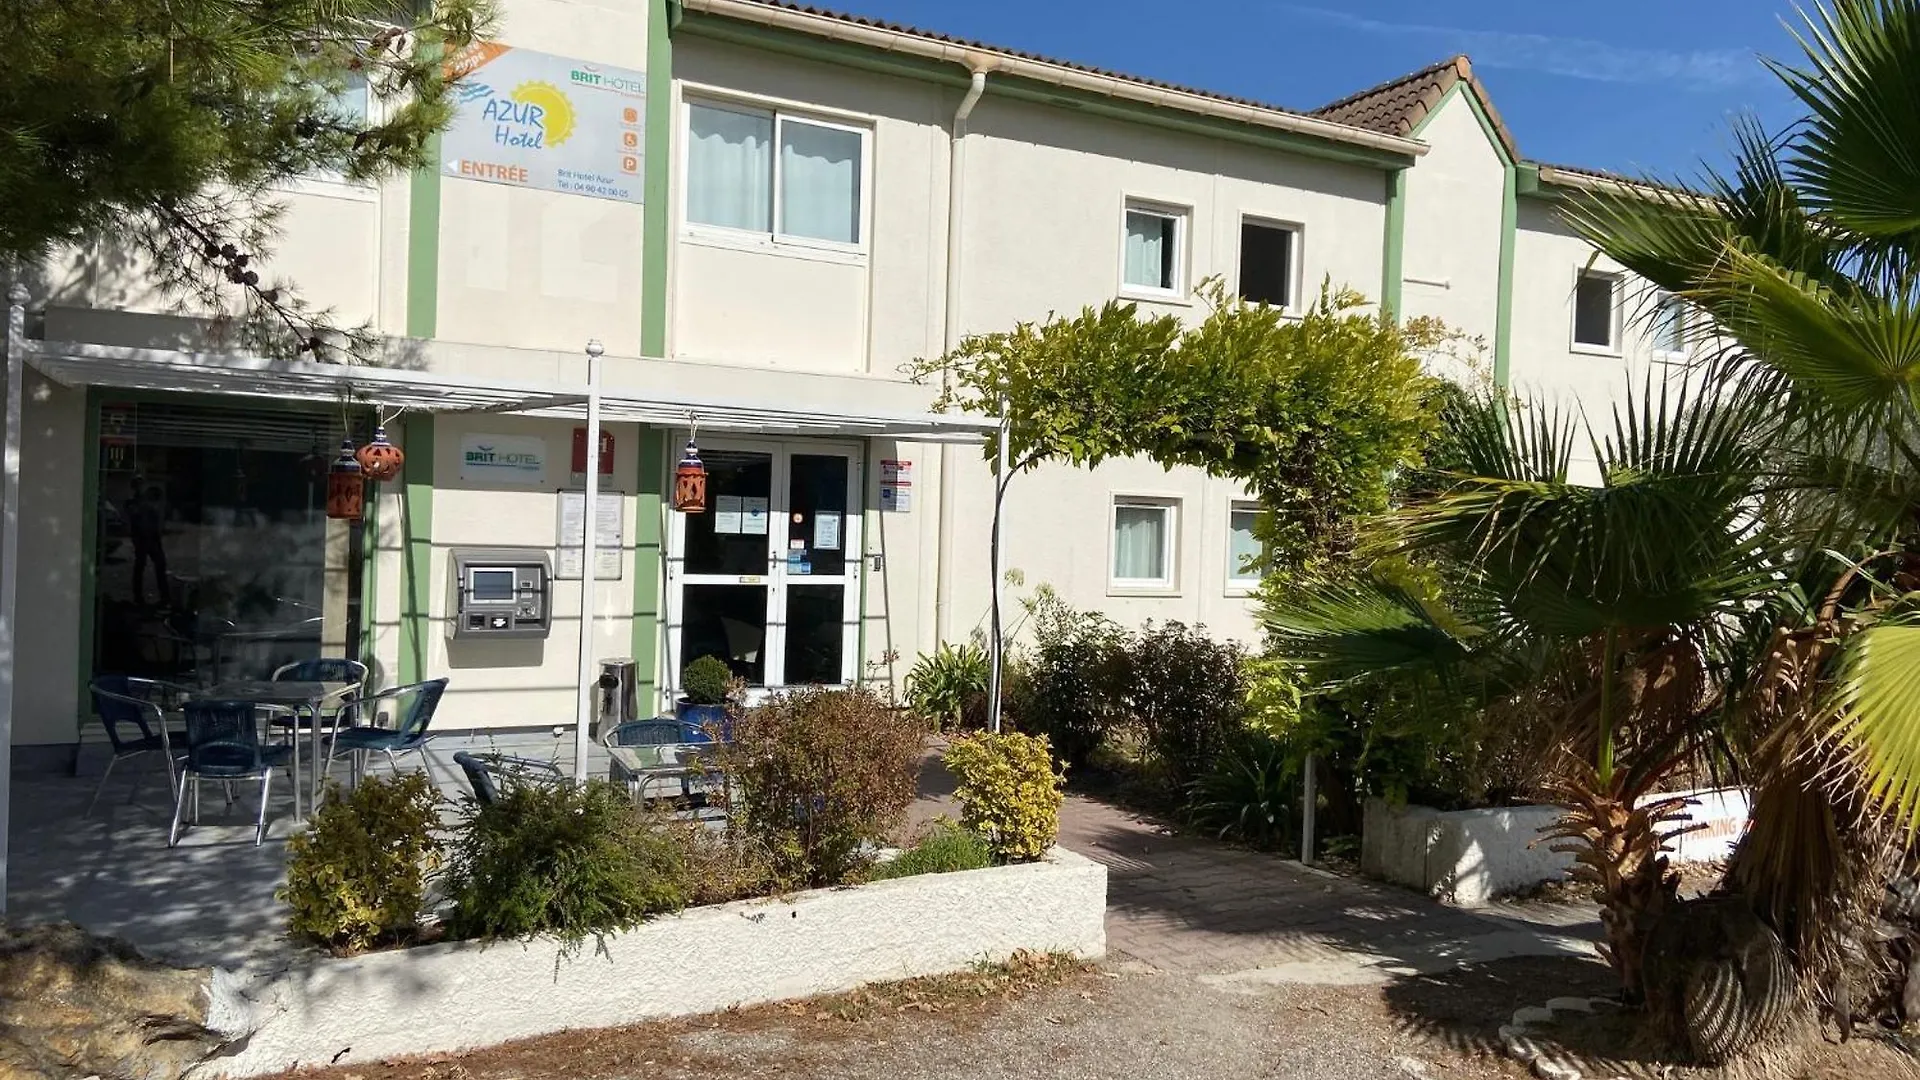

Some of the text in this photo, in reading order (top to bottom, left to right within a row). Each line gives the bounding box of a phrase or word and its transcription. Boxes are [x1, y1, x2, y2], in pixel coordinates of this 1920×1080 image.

[571, 70, 645, 93] BRIT HOTEL
[482, 98, 544, 129] AZUR
[495, 125, 543, 150] Hotel
[461, 160, 529, 183] ENTRÉE
[557, 168, 572, 178] Brit
[596, 175, 614, 184] Azur
[574, 182, 584, 191] 04
[466, 451, 540, 465] BRIT HOTEL
